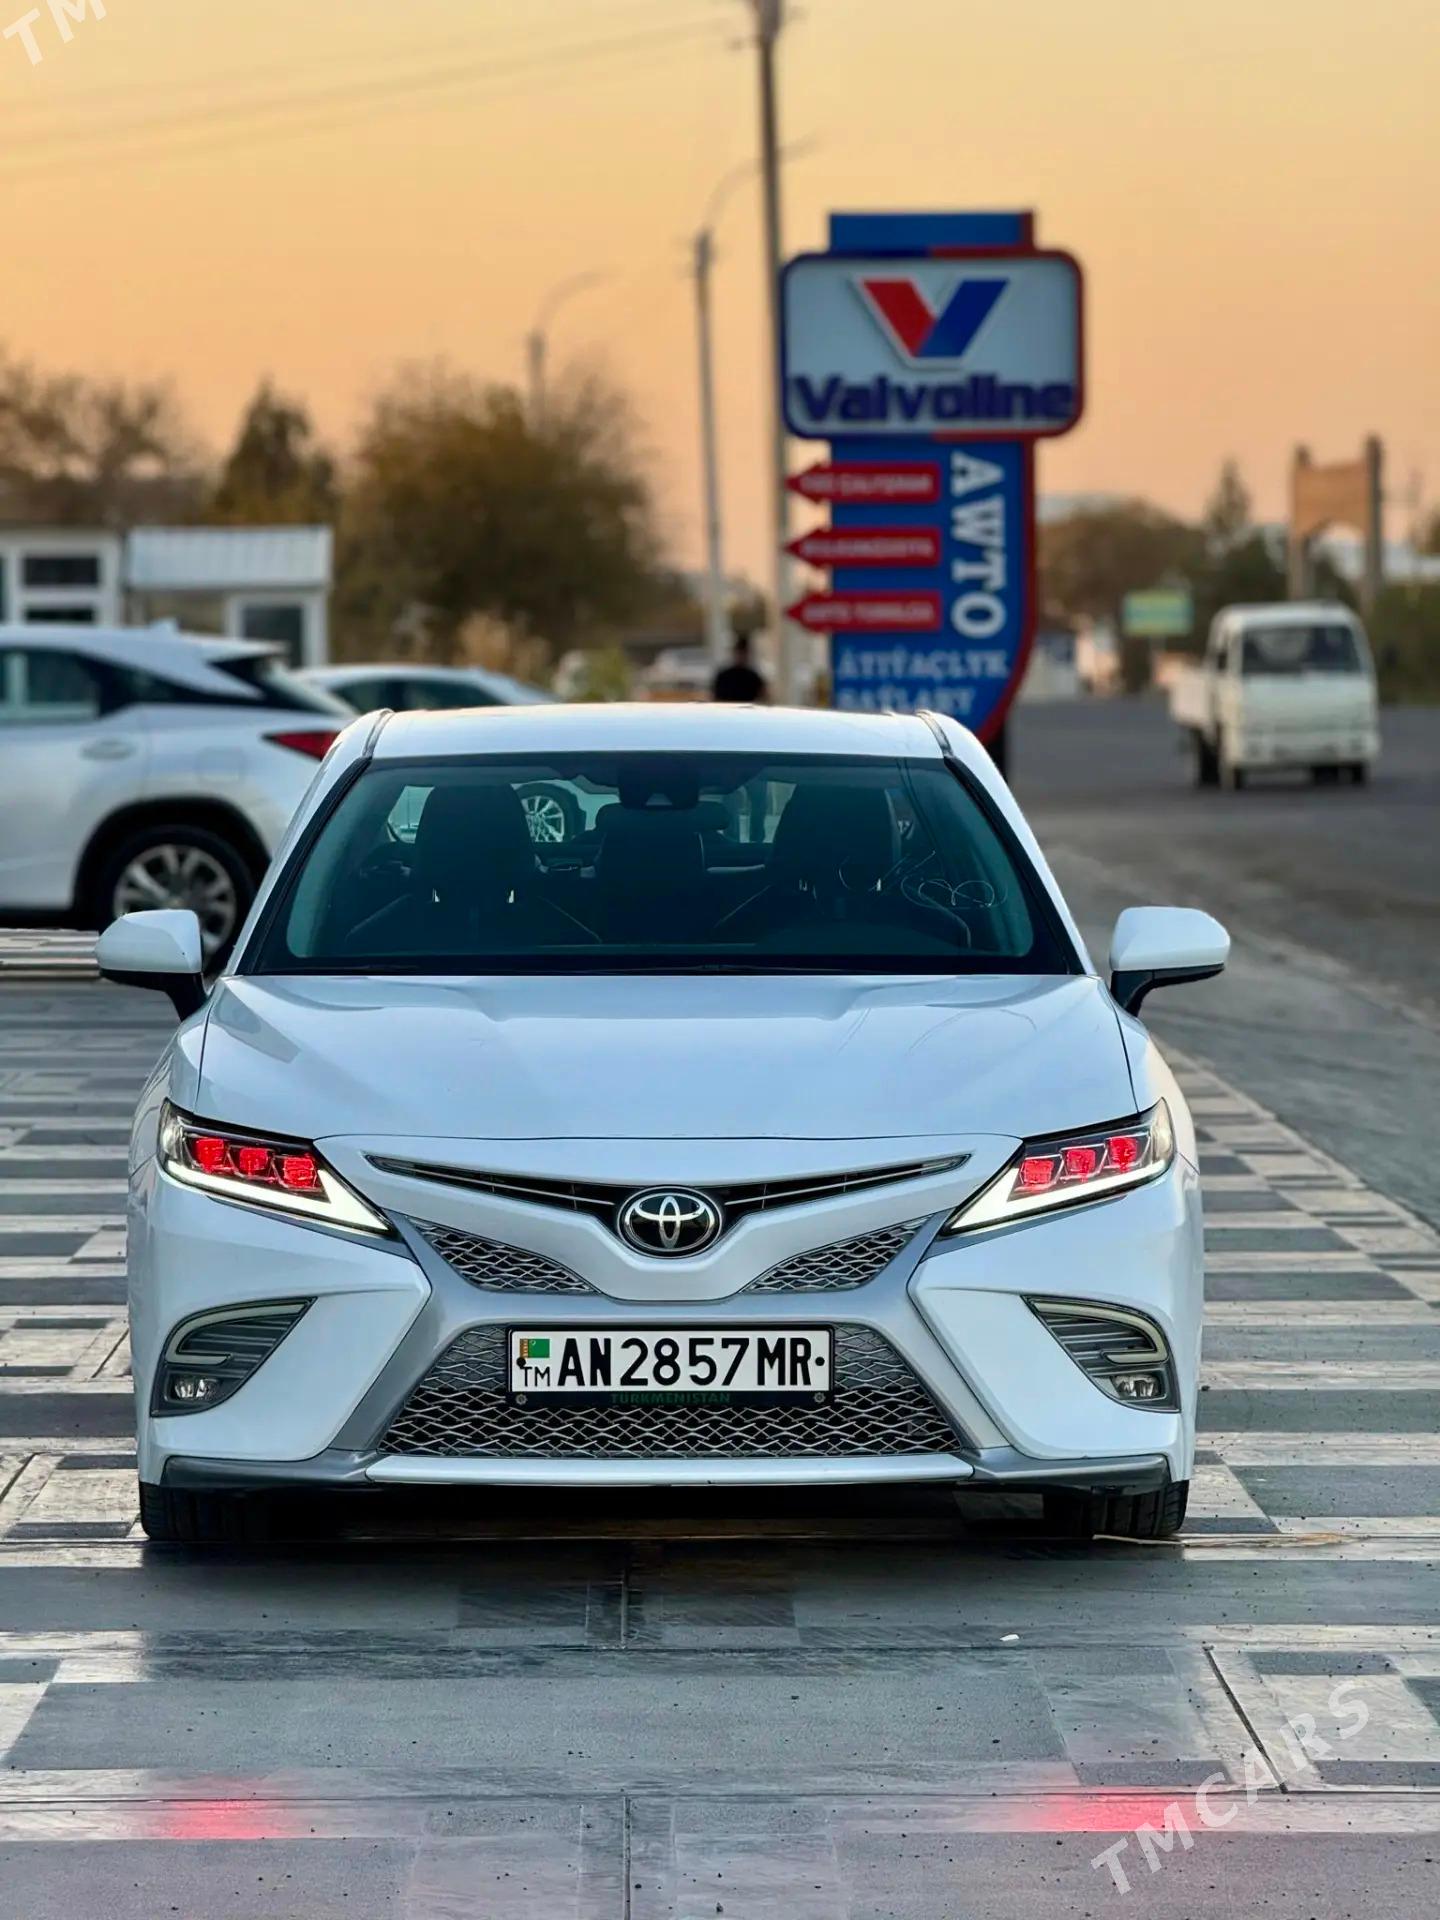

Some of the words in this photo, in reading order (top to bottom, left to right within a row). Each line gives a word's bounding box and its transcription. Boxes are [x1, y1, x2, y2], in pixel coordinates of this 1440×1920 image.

[787, 373, 1077, 422] Valvoline
[950, 449, 1007, 639] AWTO
[519, 1365, 550, 1387] TM
